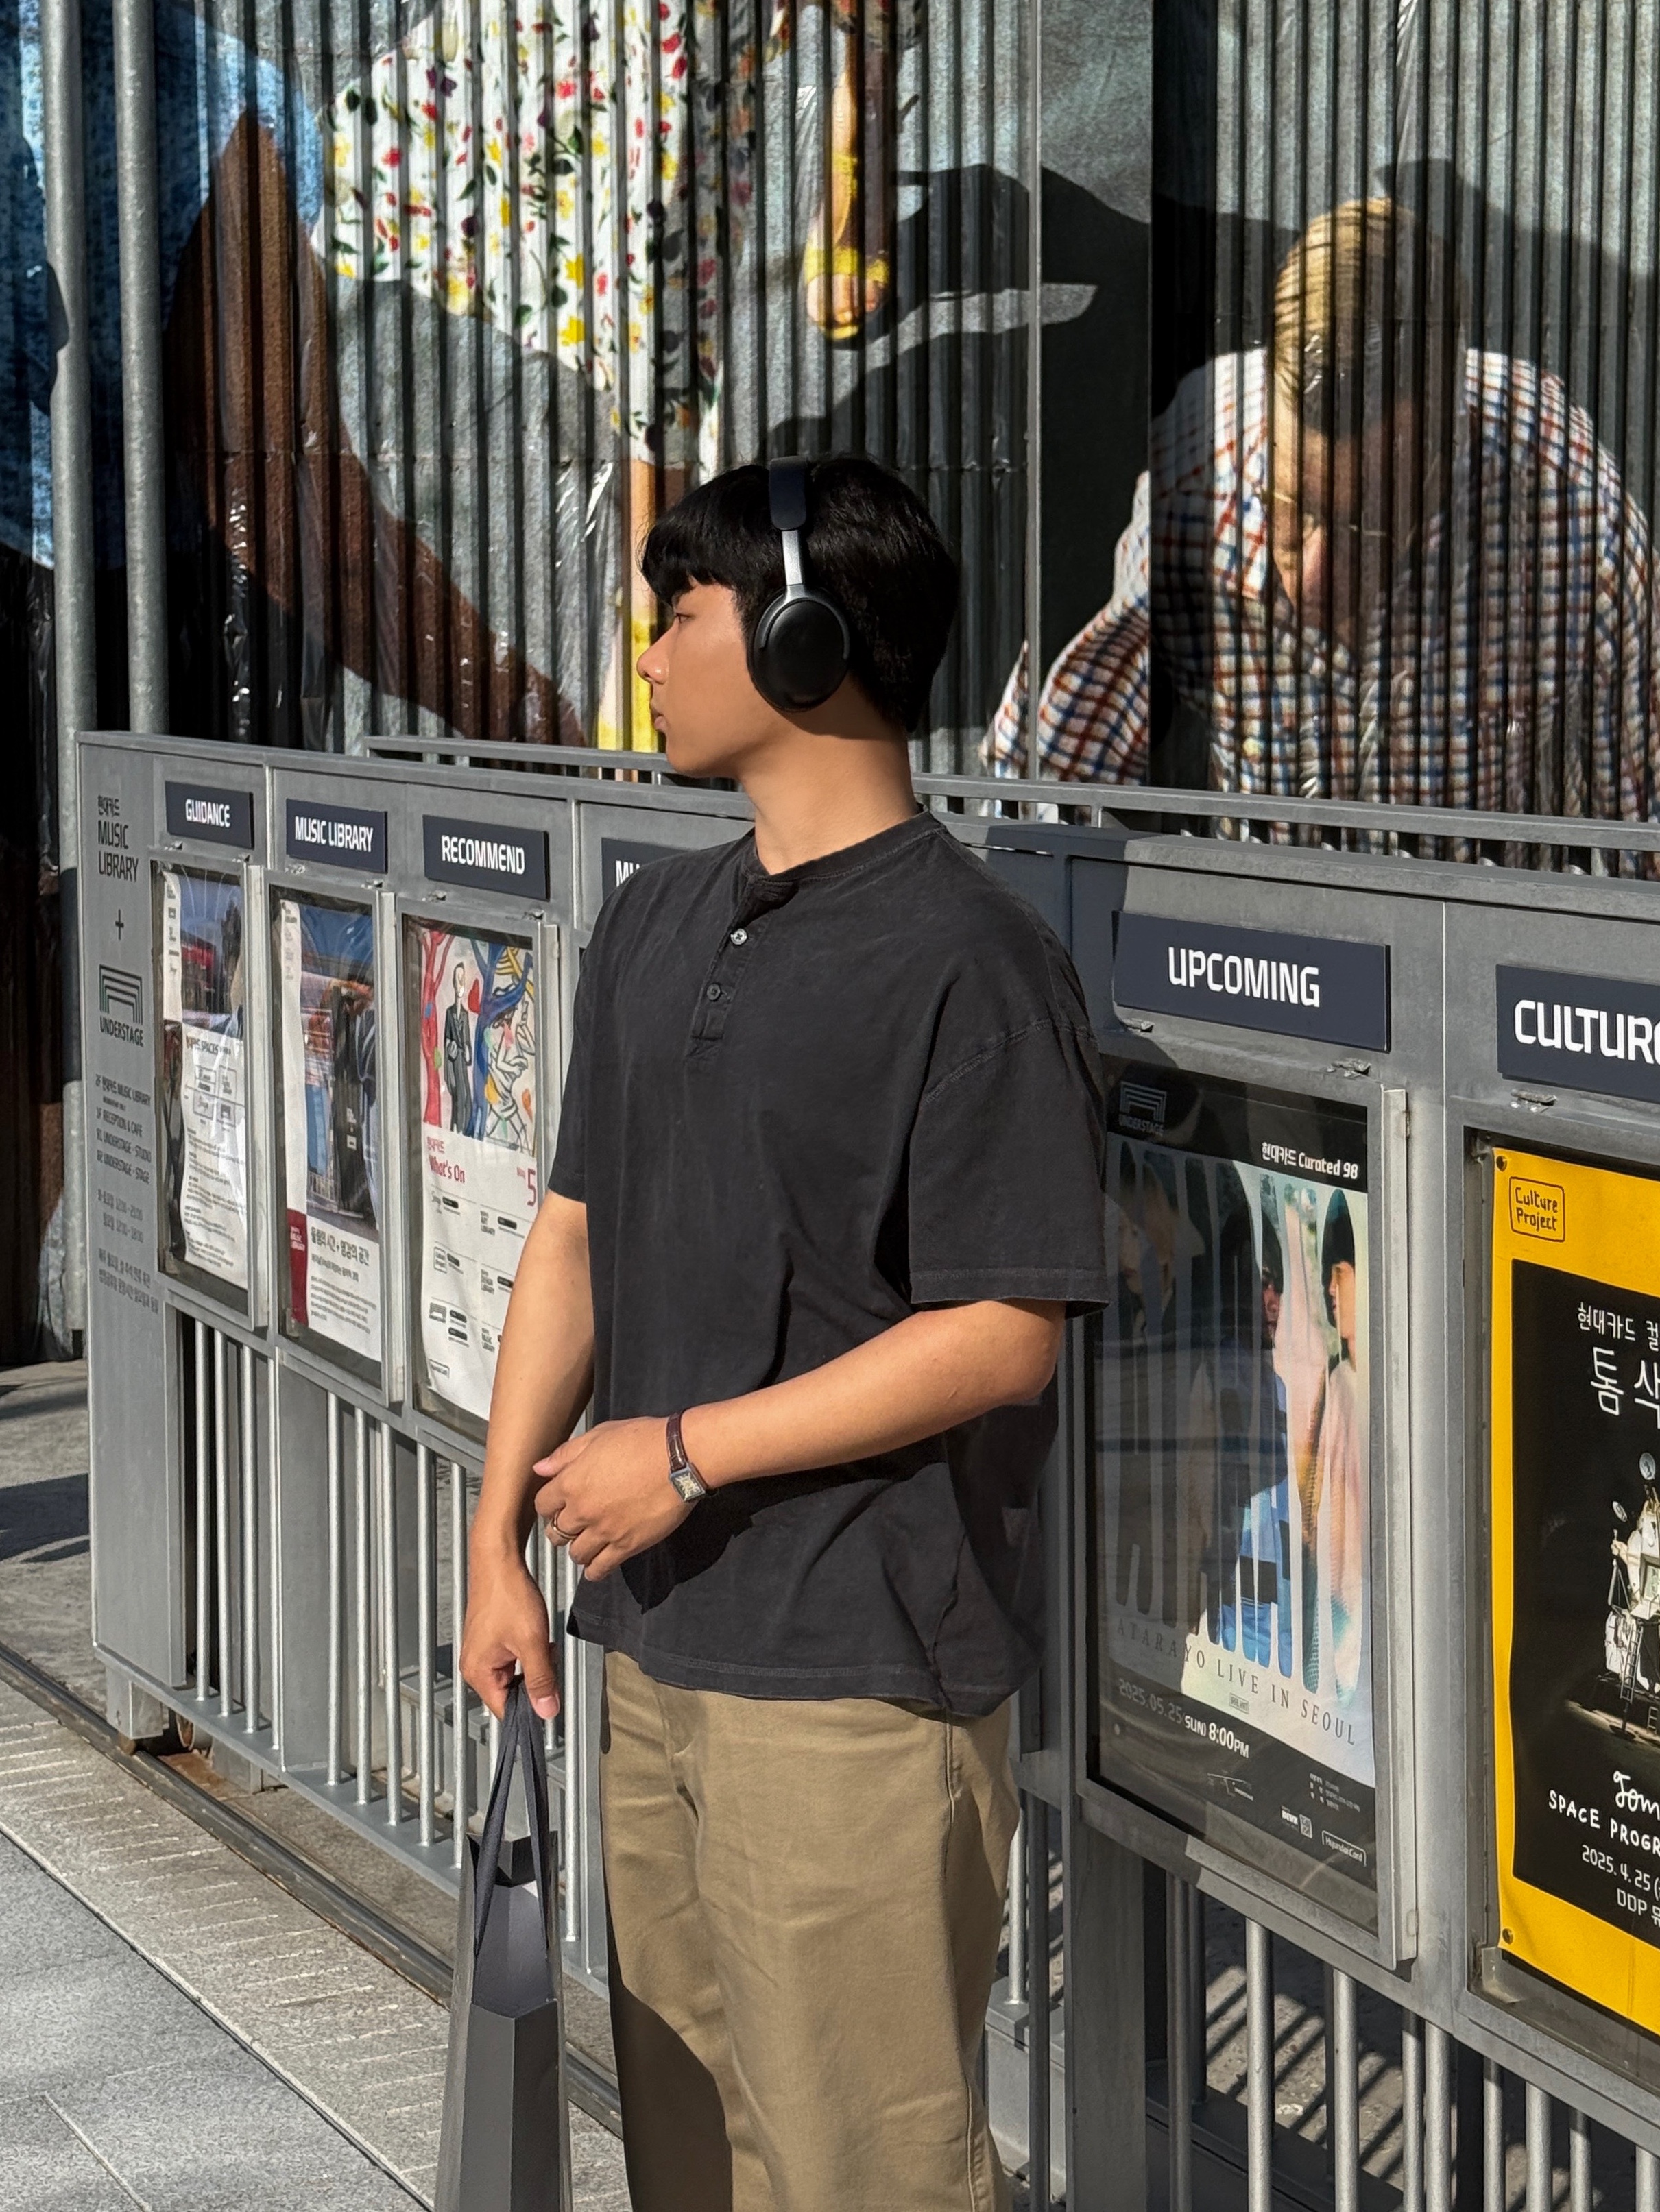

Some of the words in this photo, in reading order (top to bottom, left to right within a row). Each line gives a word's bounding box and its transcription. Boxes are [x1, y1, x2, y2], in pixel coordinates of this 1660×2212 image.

[185, 798, 230, 828] GUIDANCE
[97, 820, 129, 849] MUSIC
[295, 816, 327, 845] MUSIC
[328, 821, 374, 853] LIBRARY
[98, 851, 139, 882] LIBRARY
[441, 834, 526, 875] RECOMMEND
[616, 860, 640, 887] M
[1167, 946, 1320, 1008] UPCOMING
[99, 1015, 144, 1047] UNDERSTAGE
[454, 1165, 466, 1184] On
[1262, 1141, 1297, 1166] 현대카드
[1298, 1152, 1341, 1177] Curated
[1343, 1162, 1358, 1180] 98
[527, 1168, 536, 1207] 5
[1515, 1187, 1559, 1213] Culture
[1516, 1206, 1558, 1232] Project
[1578, 1301, 1636, 1341] 현대카드
[1590, 1346, 1624, 1416] 톰
[1117, 1618, 1205, 1668] ATARAYO
[1217, 1659, 1259, 1694] LIVE
[1271, 1684, 1290, 1709] IN
[1301, 1699, 1356, 1746] SEOUL
[1548, 1789, 1601, 1830] SPACE
[1613, 1770, 1660, 1821] Tom
[1616, 1887, 1648, 1916] DDP
